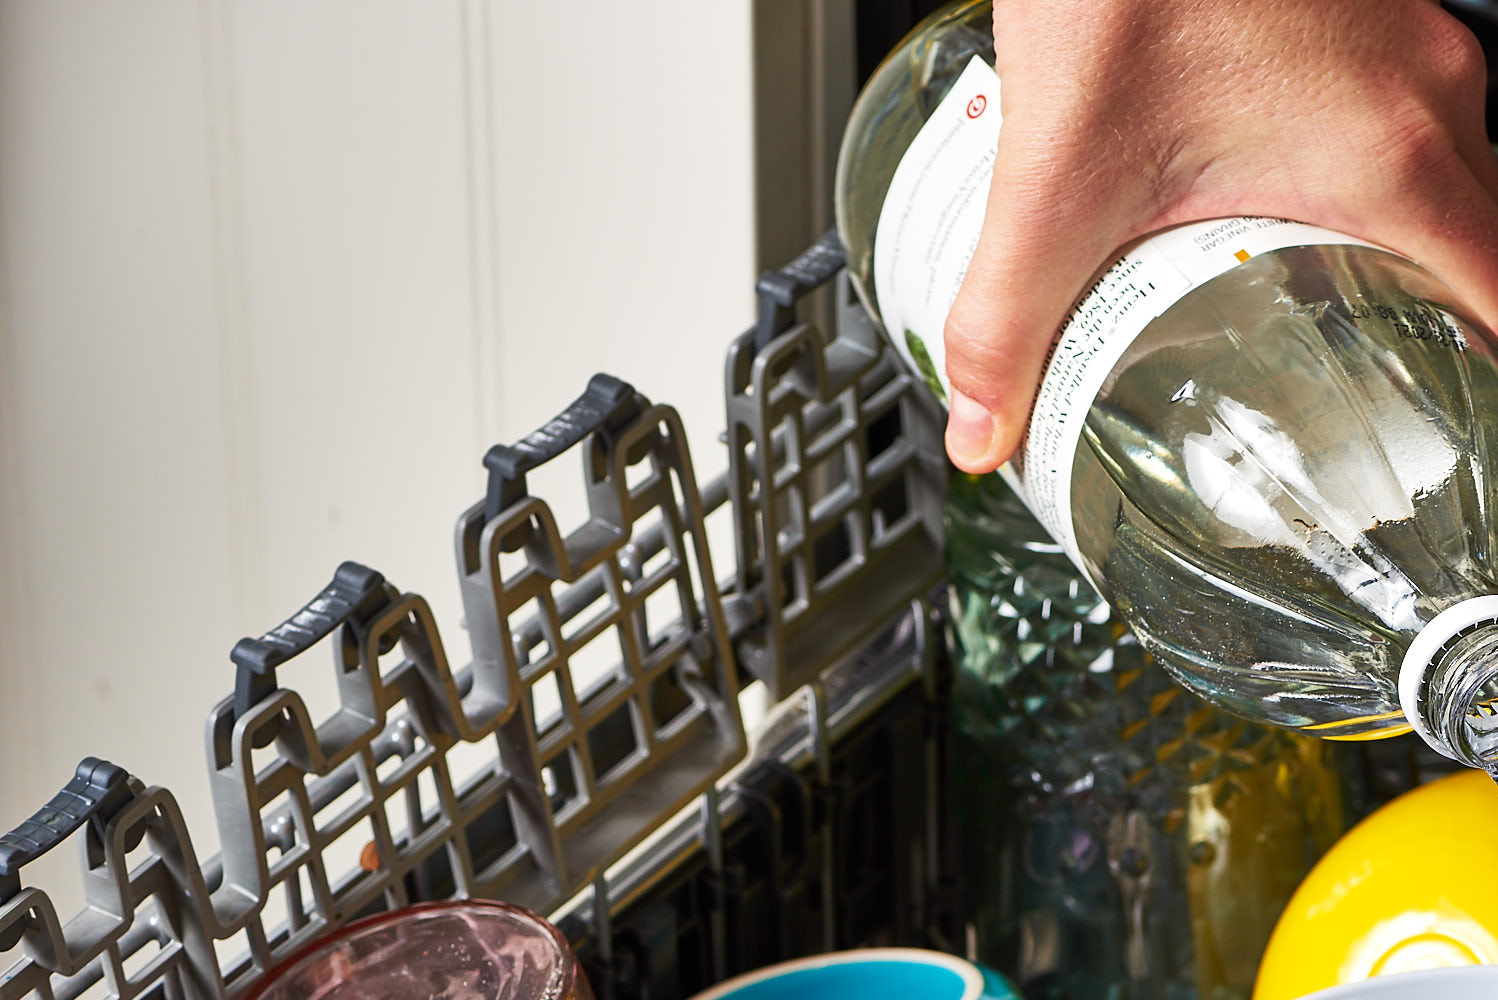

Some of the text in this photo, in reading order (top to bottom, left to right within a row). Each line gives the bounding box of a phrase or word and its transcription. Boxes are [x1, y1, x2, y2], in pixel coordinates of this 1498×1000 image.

[1194, 219, 1241, 244] GRAINS)
[1200, 225, 1252, 252] VINEGAR
[1108, 259, 1143, 293] since
[1073, 276, 1107, 314] ideal
[1103, 282, 1136, 314] been
[1083, 318, 1102, 342] the
[1051, 339, 1077, 376] With
[1065, 336, 1105, 406] Distilled
[1042, 380, 1055, 399] its
[1052, 344, 1084, 411] Natural
[1051, 412, 1068, 460] White
